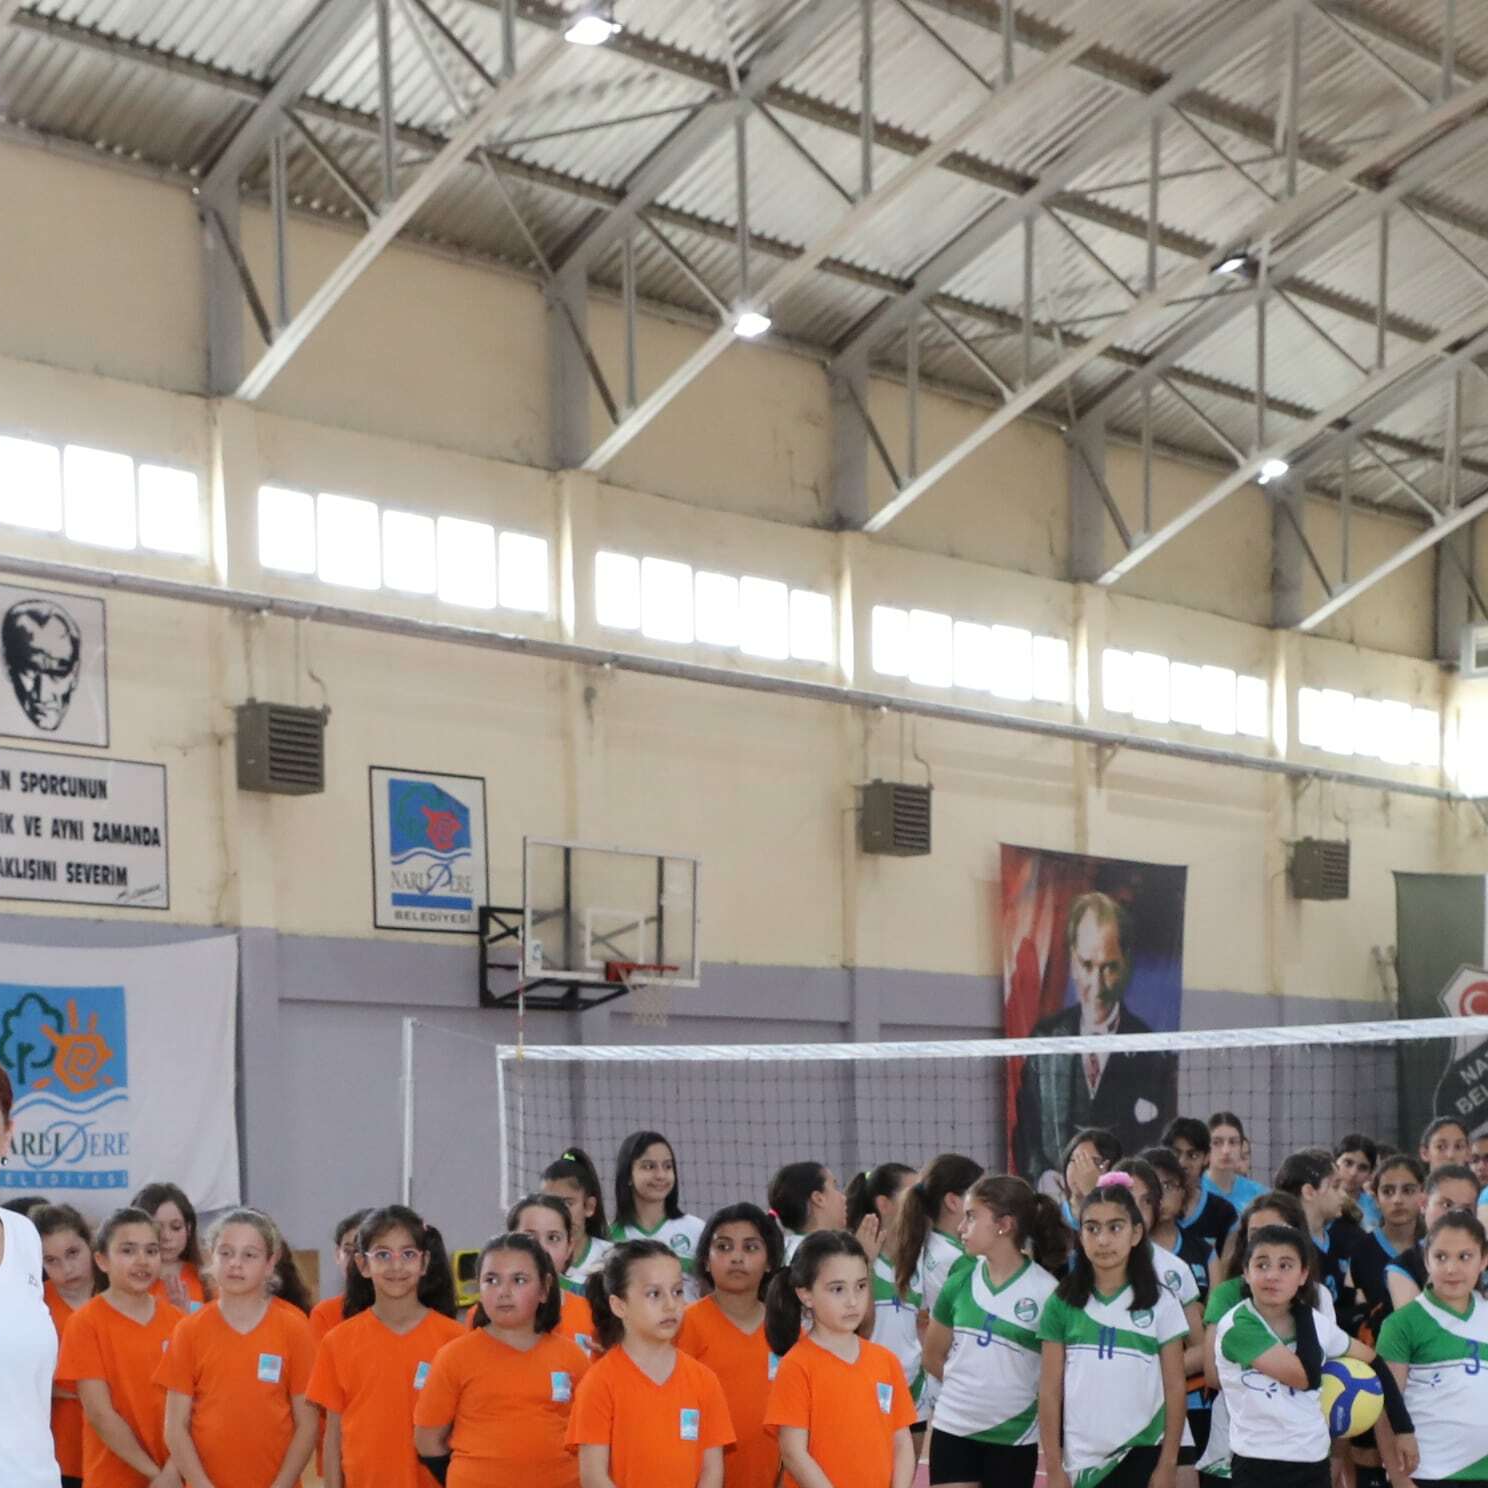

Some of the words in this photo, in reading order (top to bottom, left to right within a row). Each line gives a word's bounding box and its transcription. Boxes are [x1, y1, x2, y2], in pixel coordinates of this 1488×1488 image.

[20, 771, 108, 800] SPORCUNUN
[23, 816, 42, 838] VE
[51, 818, 84, 842] AYNI
[93, 821, 161, 847] ZAMANDA
[1098, 1325, 1117, 1360] 11
[1465, 1339, 1481, 1375] 3
